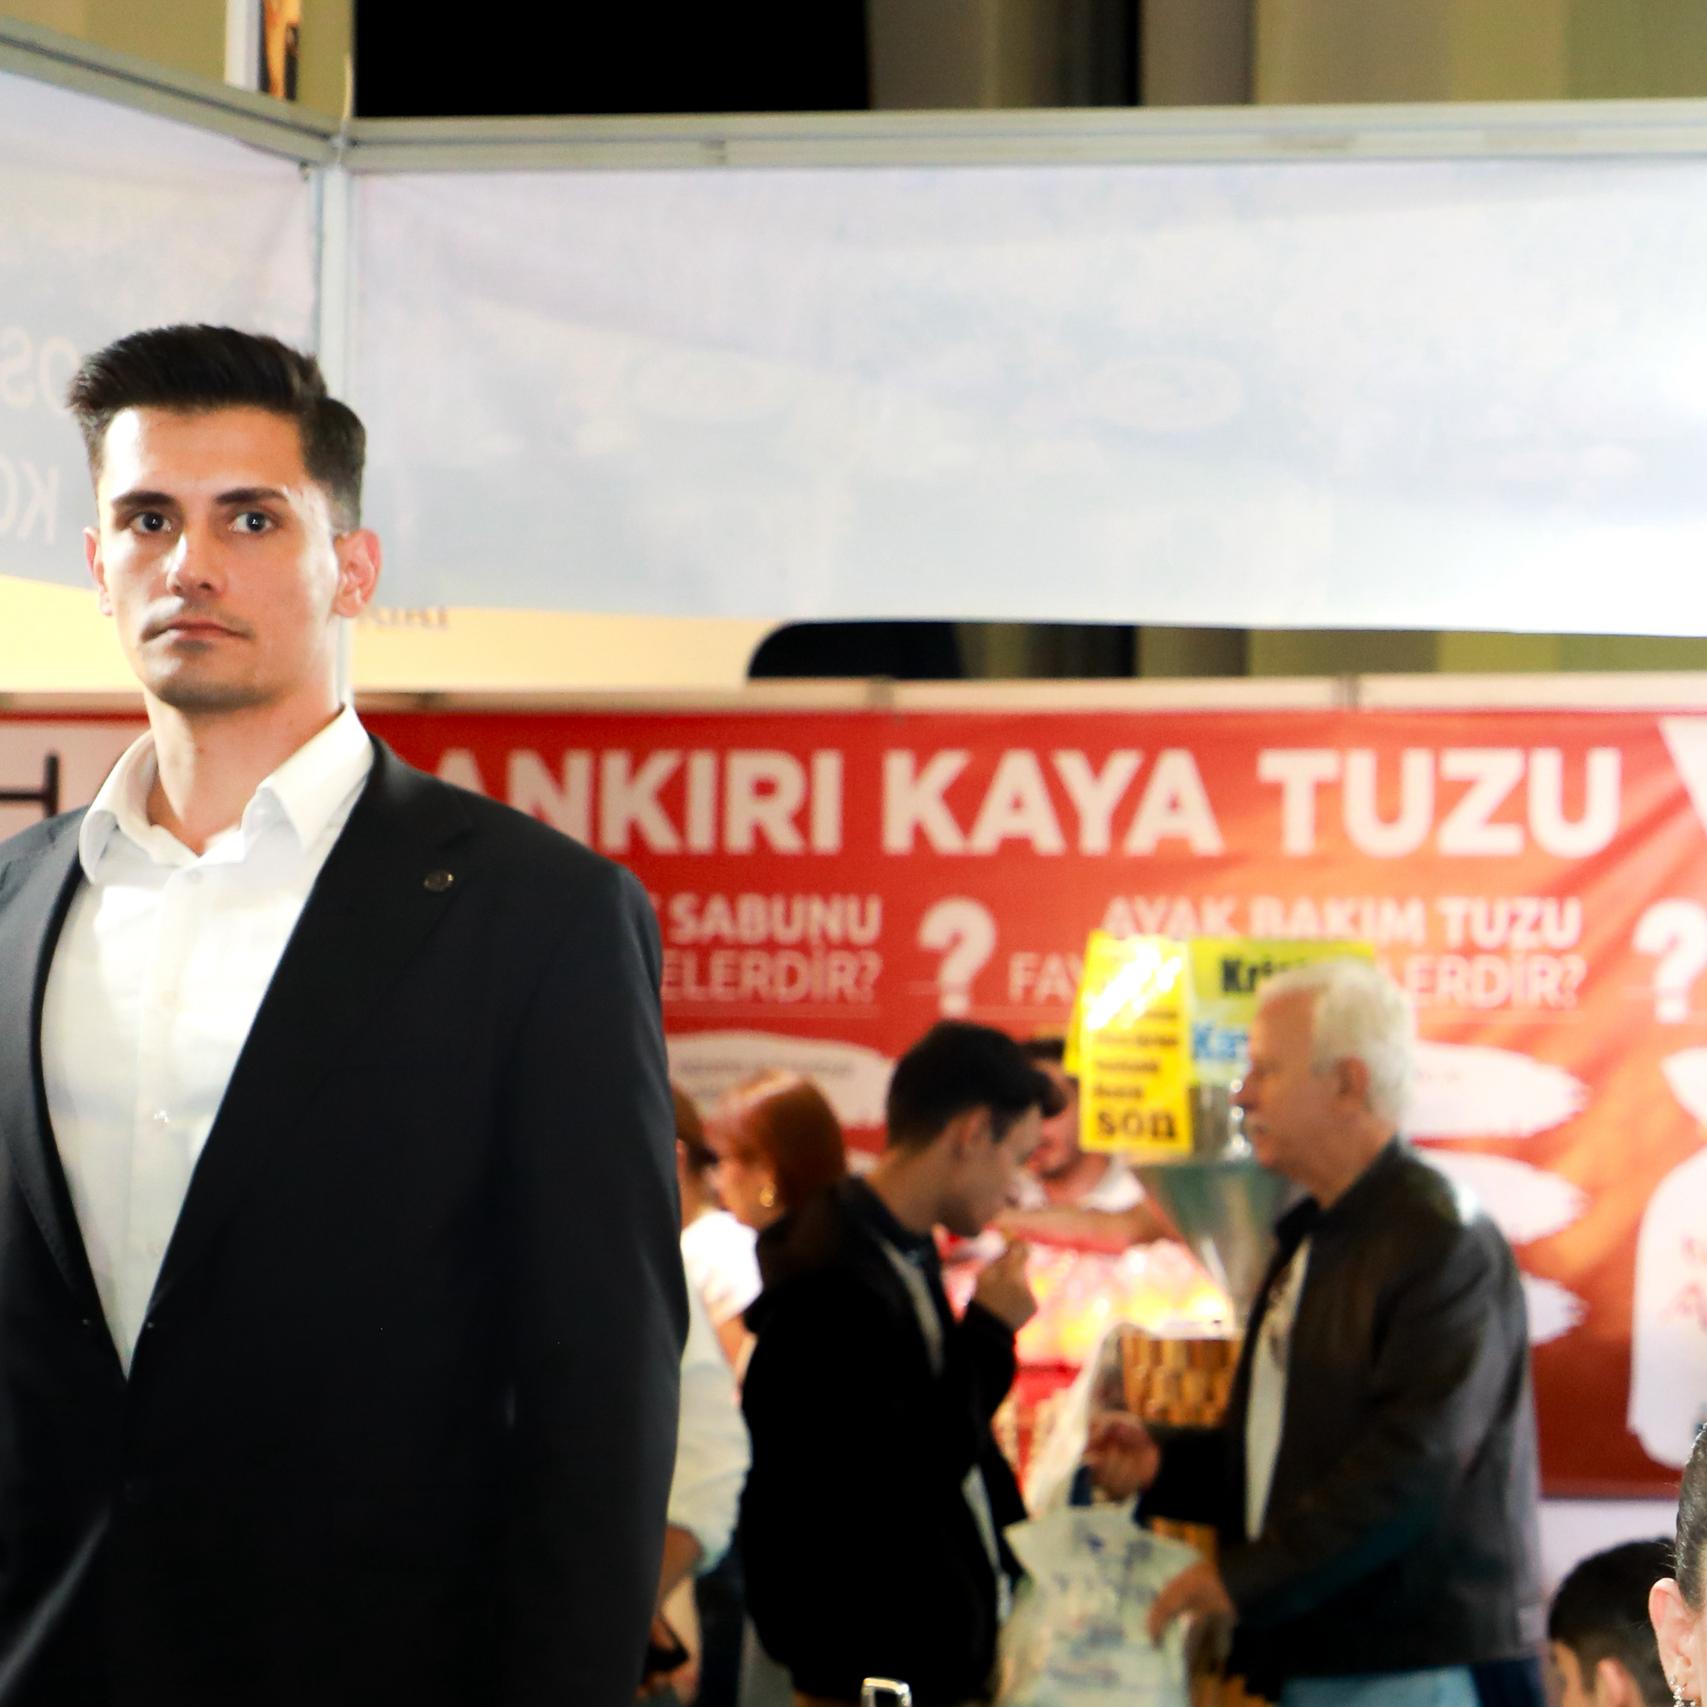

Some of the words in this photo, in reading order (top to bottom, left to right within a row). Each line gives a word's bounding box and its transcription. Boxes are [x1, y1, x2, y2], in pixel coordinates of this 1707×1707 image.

[433, 747, 844, 856] NKIRI
[881, 747, 1225, 857] KAYA
[1256, 746, 1622, 858] TUZU
[668, 893, 883, 945] SABUNU
[1435, 895, 1582, 950] TUZU
[661, 943, 883, 1003] ELERDİR?
